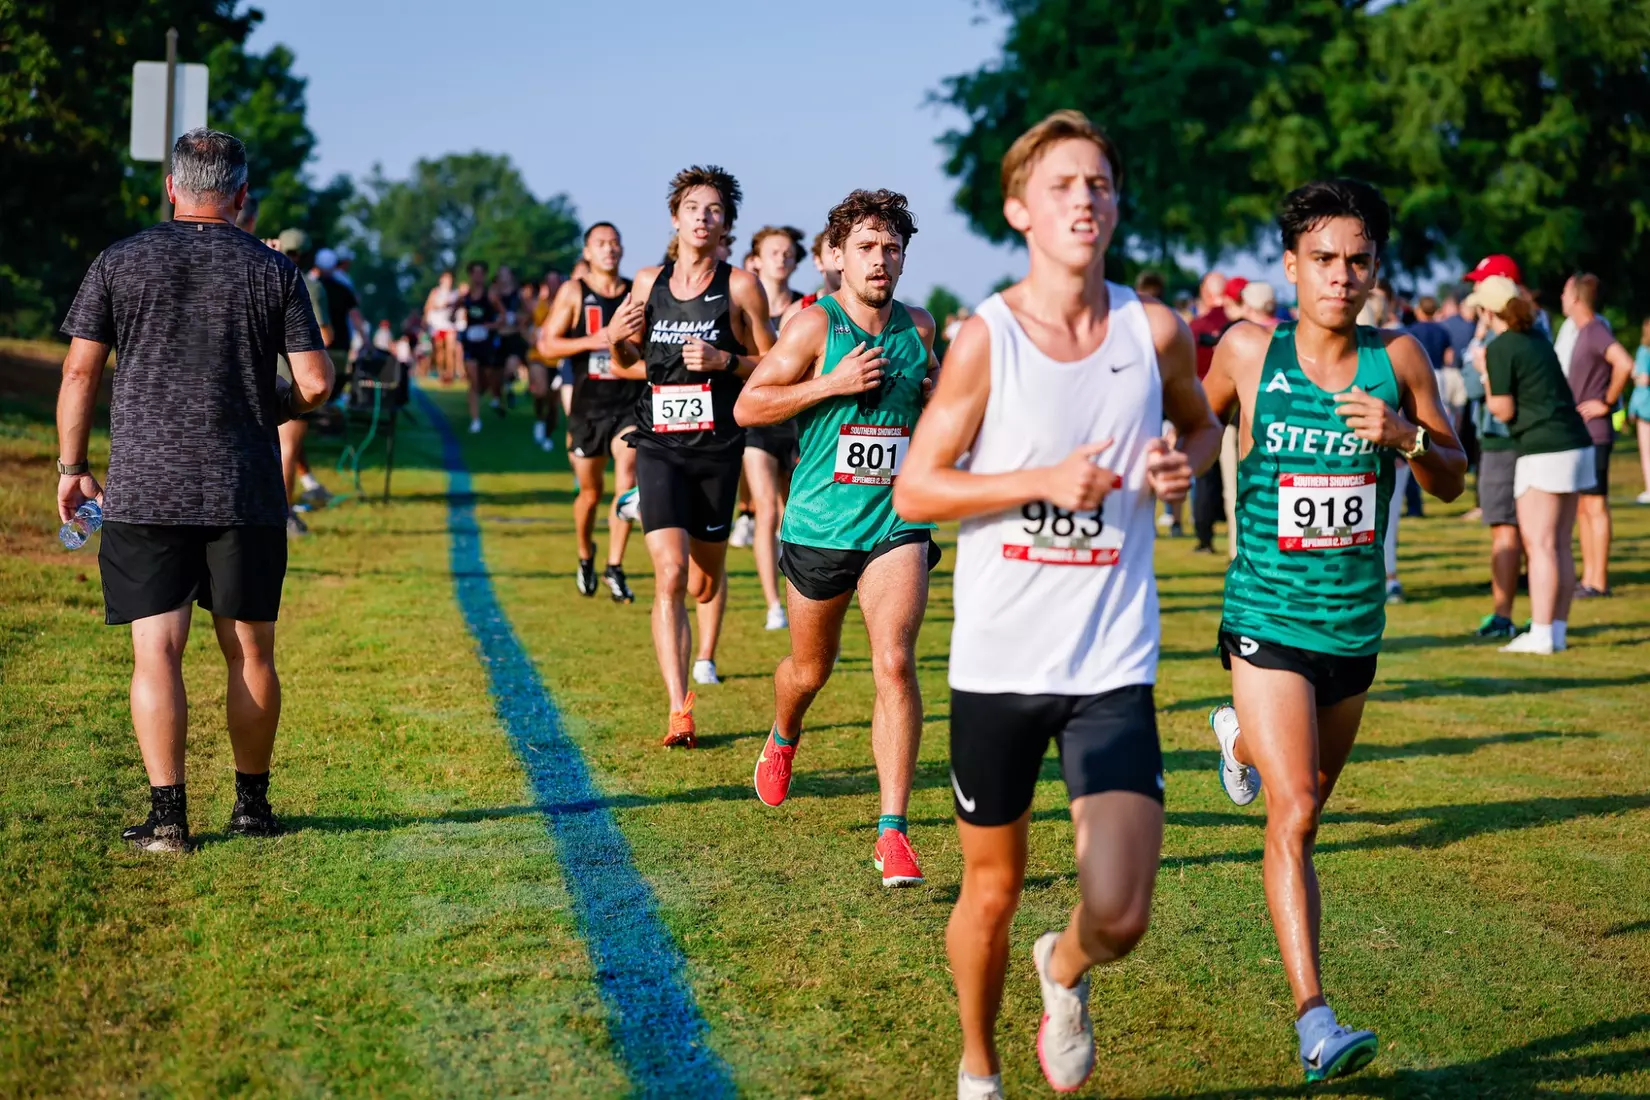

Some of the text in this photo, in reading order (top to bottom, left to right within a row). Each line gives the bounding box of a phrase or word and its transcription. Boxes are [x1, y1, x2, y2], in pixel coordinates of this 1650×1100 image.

[662, 398, 704, 419] 573
[850, 426, 902, 436] SOUTHERN SHOWCASE
[1266, 422, 1389, 456] STETSO
[847, 442, 897, 470] 801
[1293, 474, 1365, 487] SOUTHERN SHOWCASE
[1022, 500, 1103, 537] 983
[1294, 496, 1363, 528] 918
